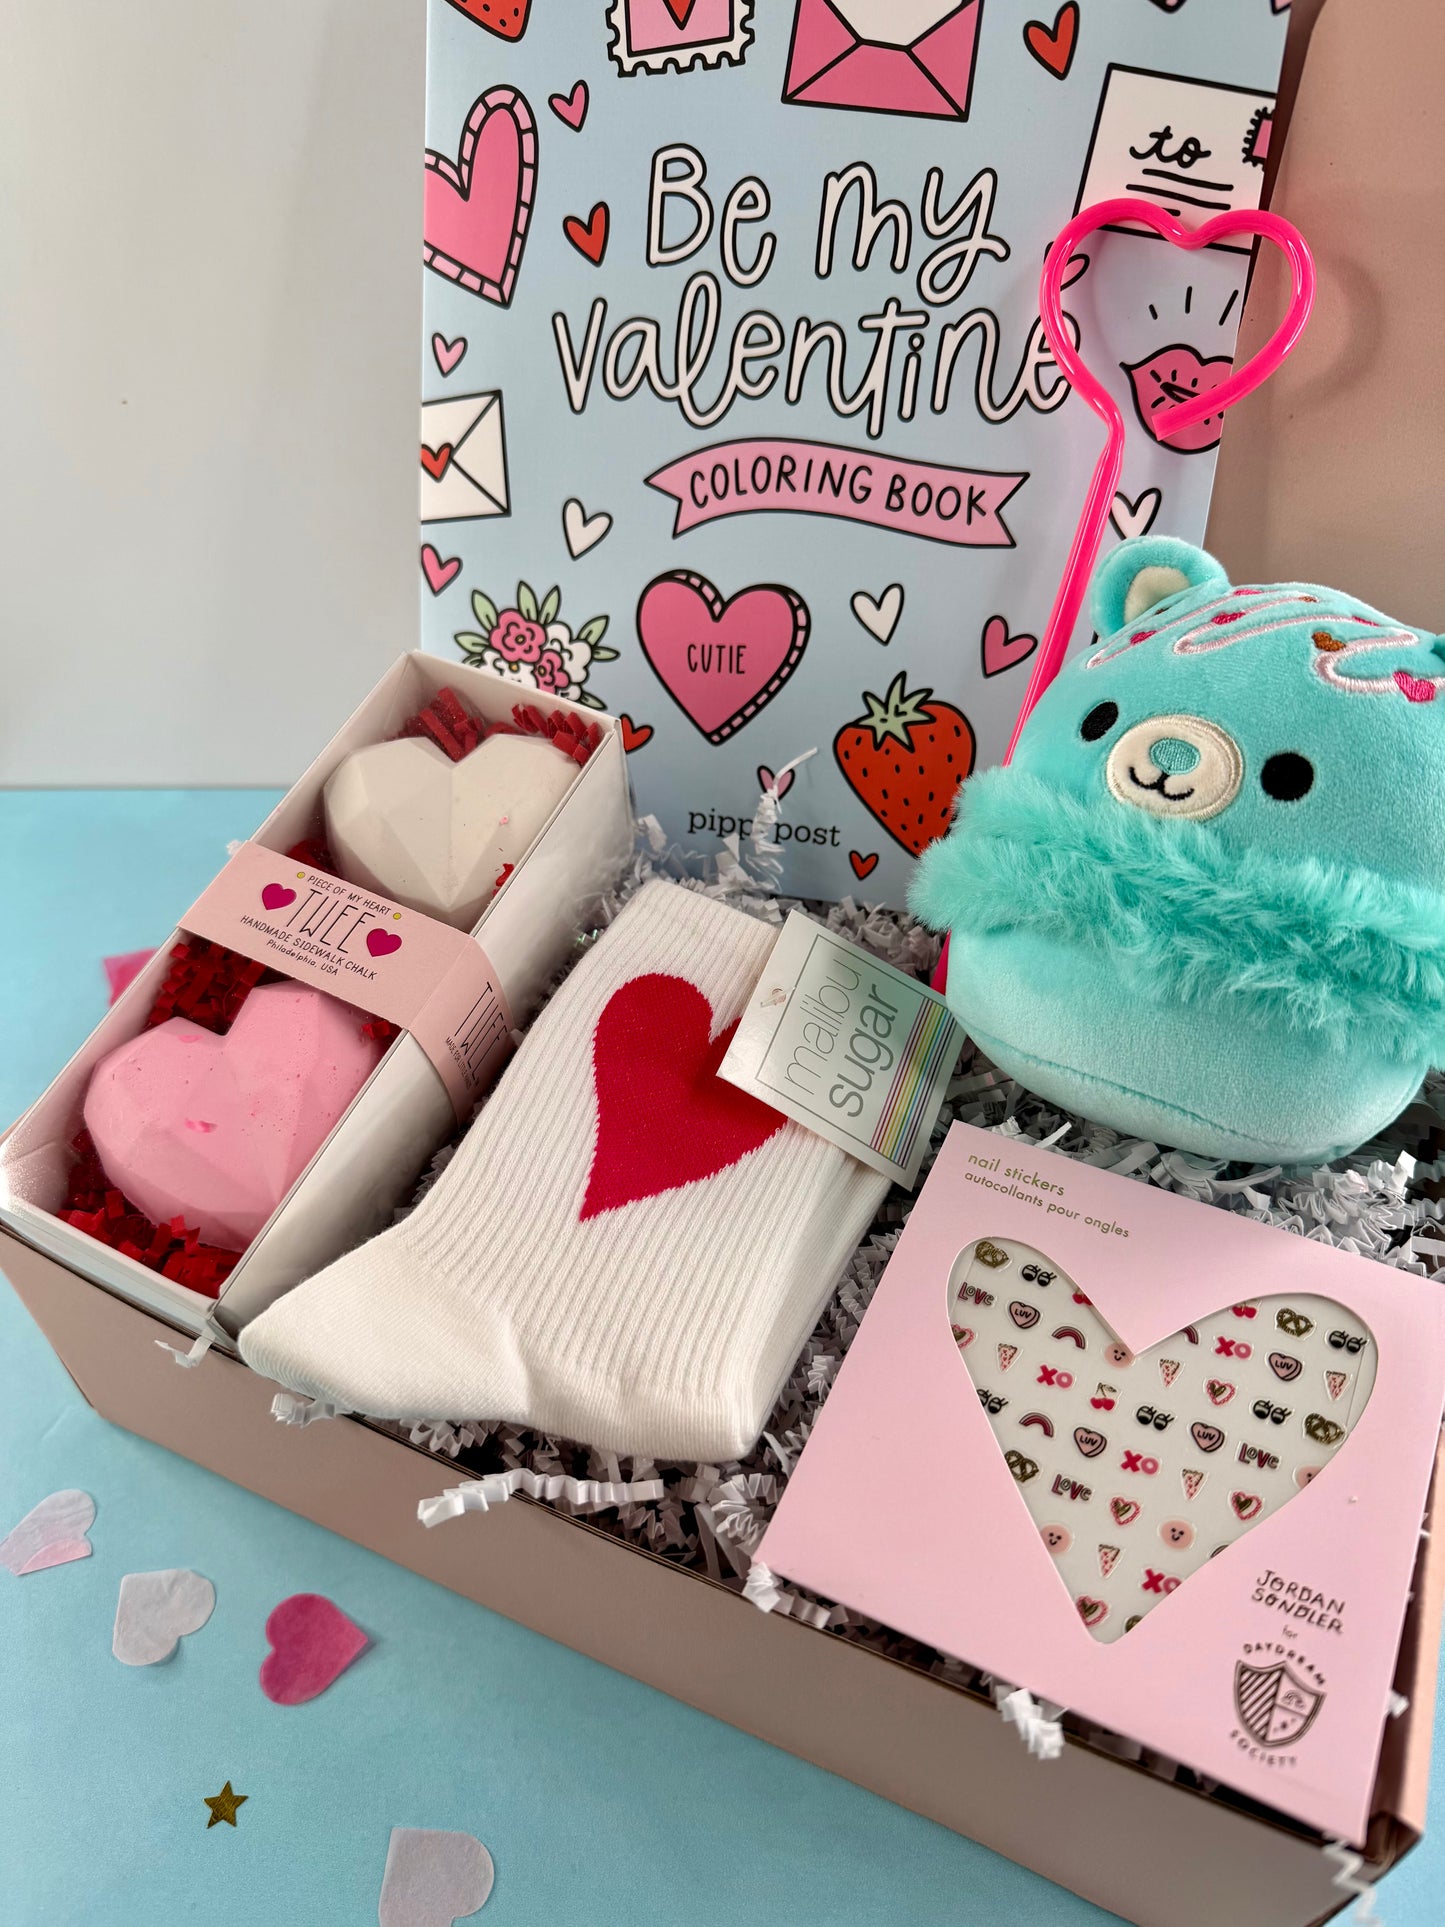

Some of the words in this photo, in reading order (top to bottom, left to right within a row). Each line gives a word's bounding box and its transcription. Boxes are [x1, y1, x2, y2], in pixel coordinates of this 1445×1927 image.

[1129, 125, 1212, 169] to
[646, 143, 777, 287] Be
[815, 160, 1010, 304] my
[690, 454, 872, 512] COLORING
[884, 476, 989, 527] BOOK
[687, 642, 748, 676] CUTIE
[688, 808, 754, 841] pipp
[773, 821, 841, 847] post
[307, 875, 334, 891] PIECE
[333, 886, 347, 896] OF
[347, 893, 362, 903] MY
[363, 899, 392, 915] HEART
[286, 888, 376, 954] TWEE
[240, 914, 293, 943] HANDMADE
[292, 937, 346, 967] SIDEWALK
[344, 960, 378, 980] CHALK
[266, 939, 317, 967] Philadelphia,
[320, 963, 339, 976] USA
[784, 958, 862, 1096] malibu
[828, 983, 899, 1118] sugar
[968, 1154, 1001, 1172] nail
[1004, 1165, 1066, 1197] stickers
[964, 1171, 1044, 1207] autocollants
[1046, 1202, 1081, 1221] pour
[1084, 1215, 1130, 1238] ongles
[1014, 1307, 1032, 1320] LUV
[1215, 1336, 1252, 1360] XO
[1274, 1359, 1294, 1371] LUV
[1036, 1364, 1074, 1389] XO
[1079, 1434, 1098, 1446] LUV
[1196, 1429, 1216, 1442] LUV
[1120, 1450, 1159, 1475] XO
[1256, 1569, 1345, 1614] JORDAN
[1242, 1642, 1327, 1687] DAYDREAM
[1229, 1729, 1297, 1767] SOCIETY
